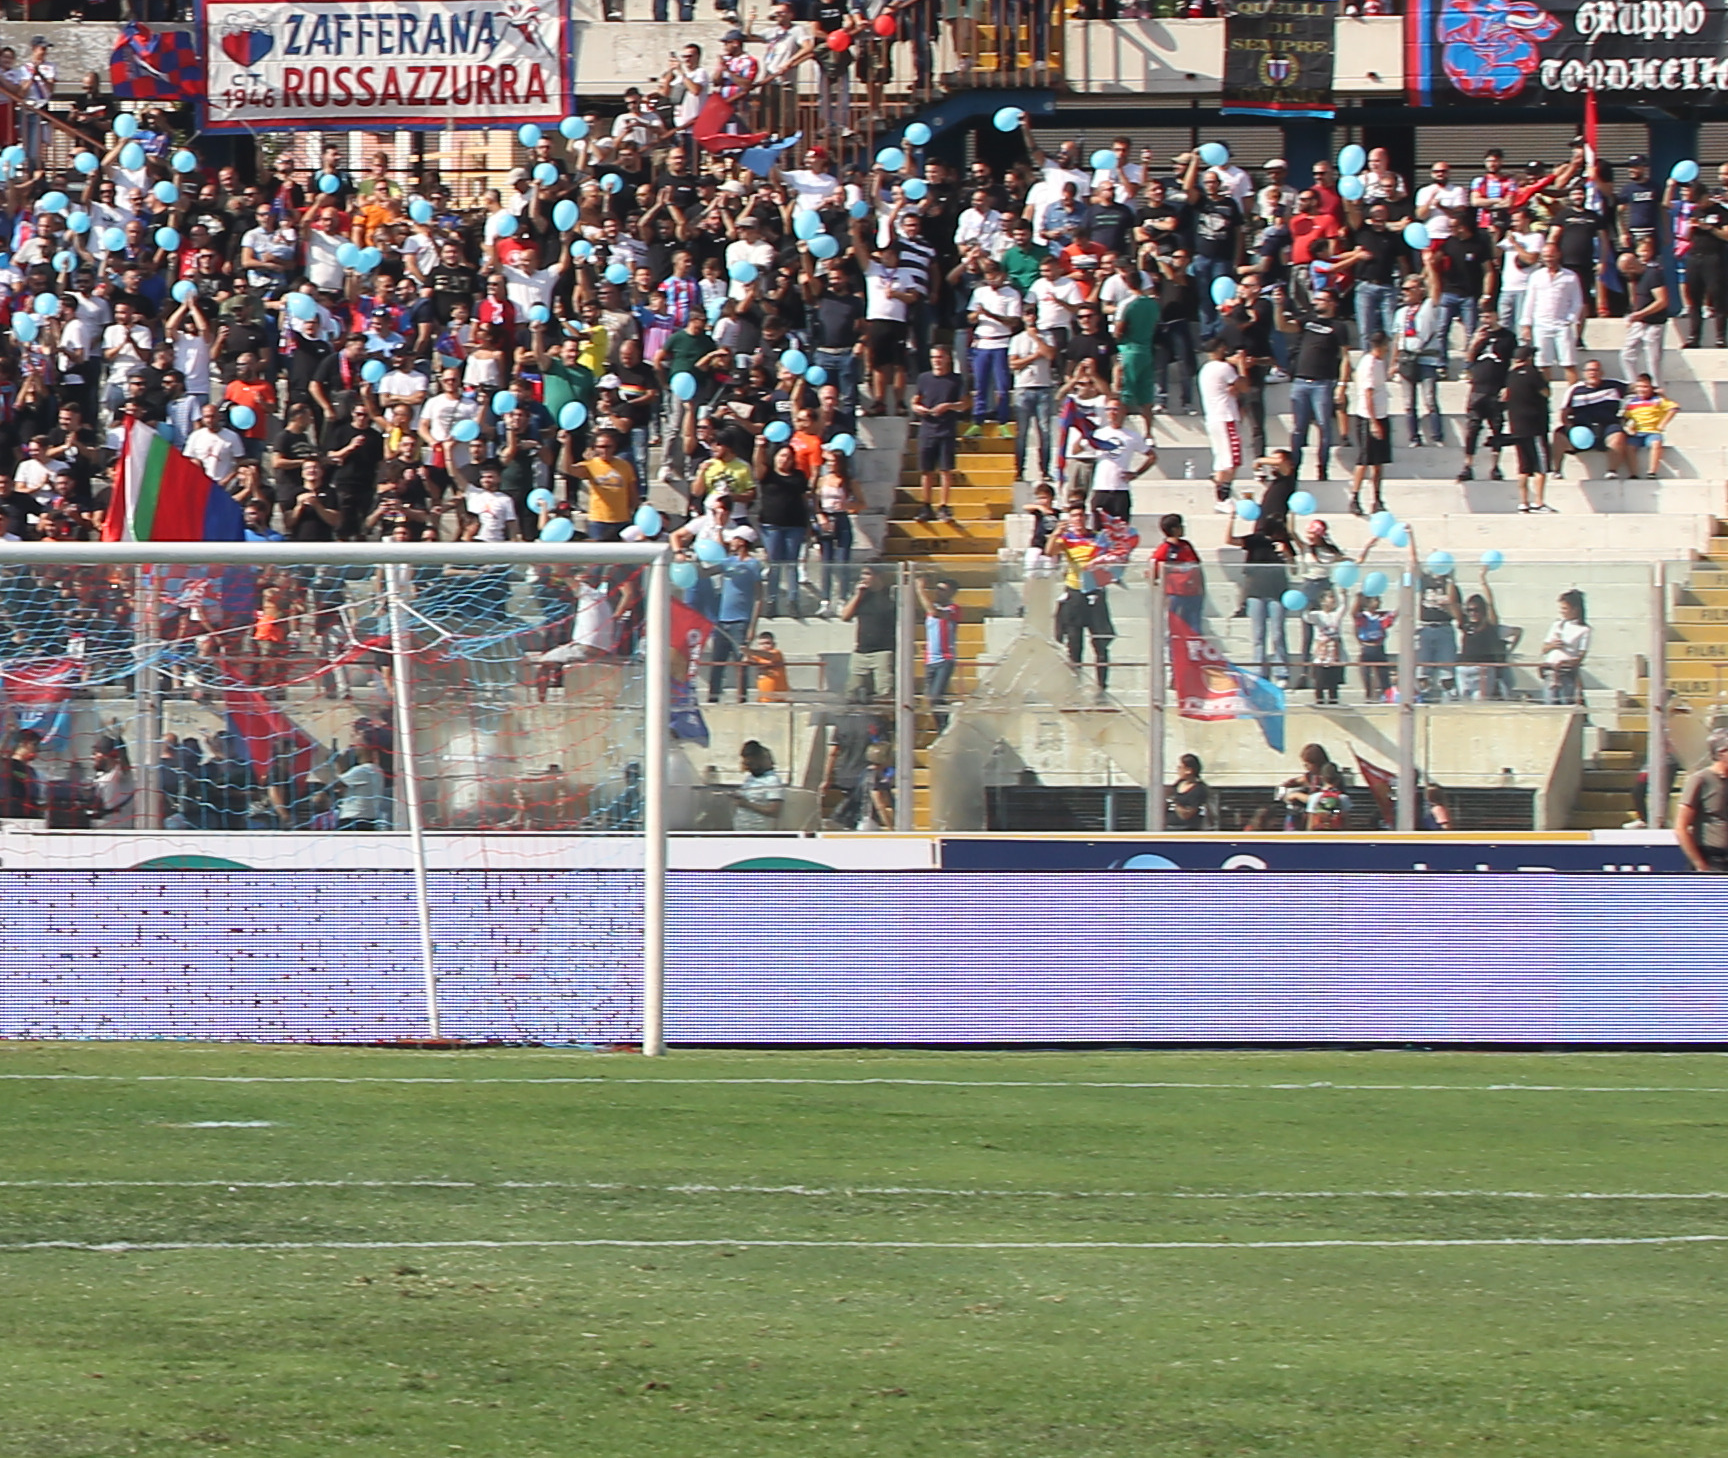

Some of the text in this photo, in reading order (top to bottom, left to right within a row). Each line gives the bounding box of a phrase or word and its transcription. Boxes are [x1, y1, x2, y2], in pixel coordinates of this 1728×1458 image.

[1237, 2, 1325, 16] QUELLI
[283, 9, 498, 57] ZAFFERANA
[1230, 39, 1329, 53] SEMPRE
[282, 63, 550, 108] ROSSAZZURRA
[220, 89, 276, 109] 1946
